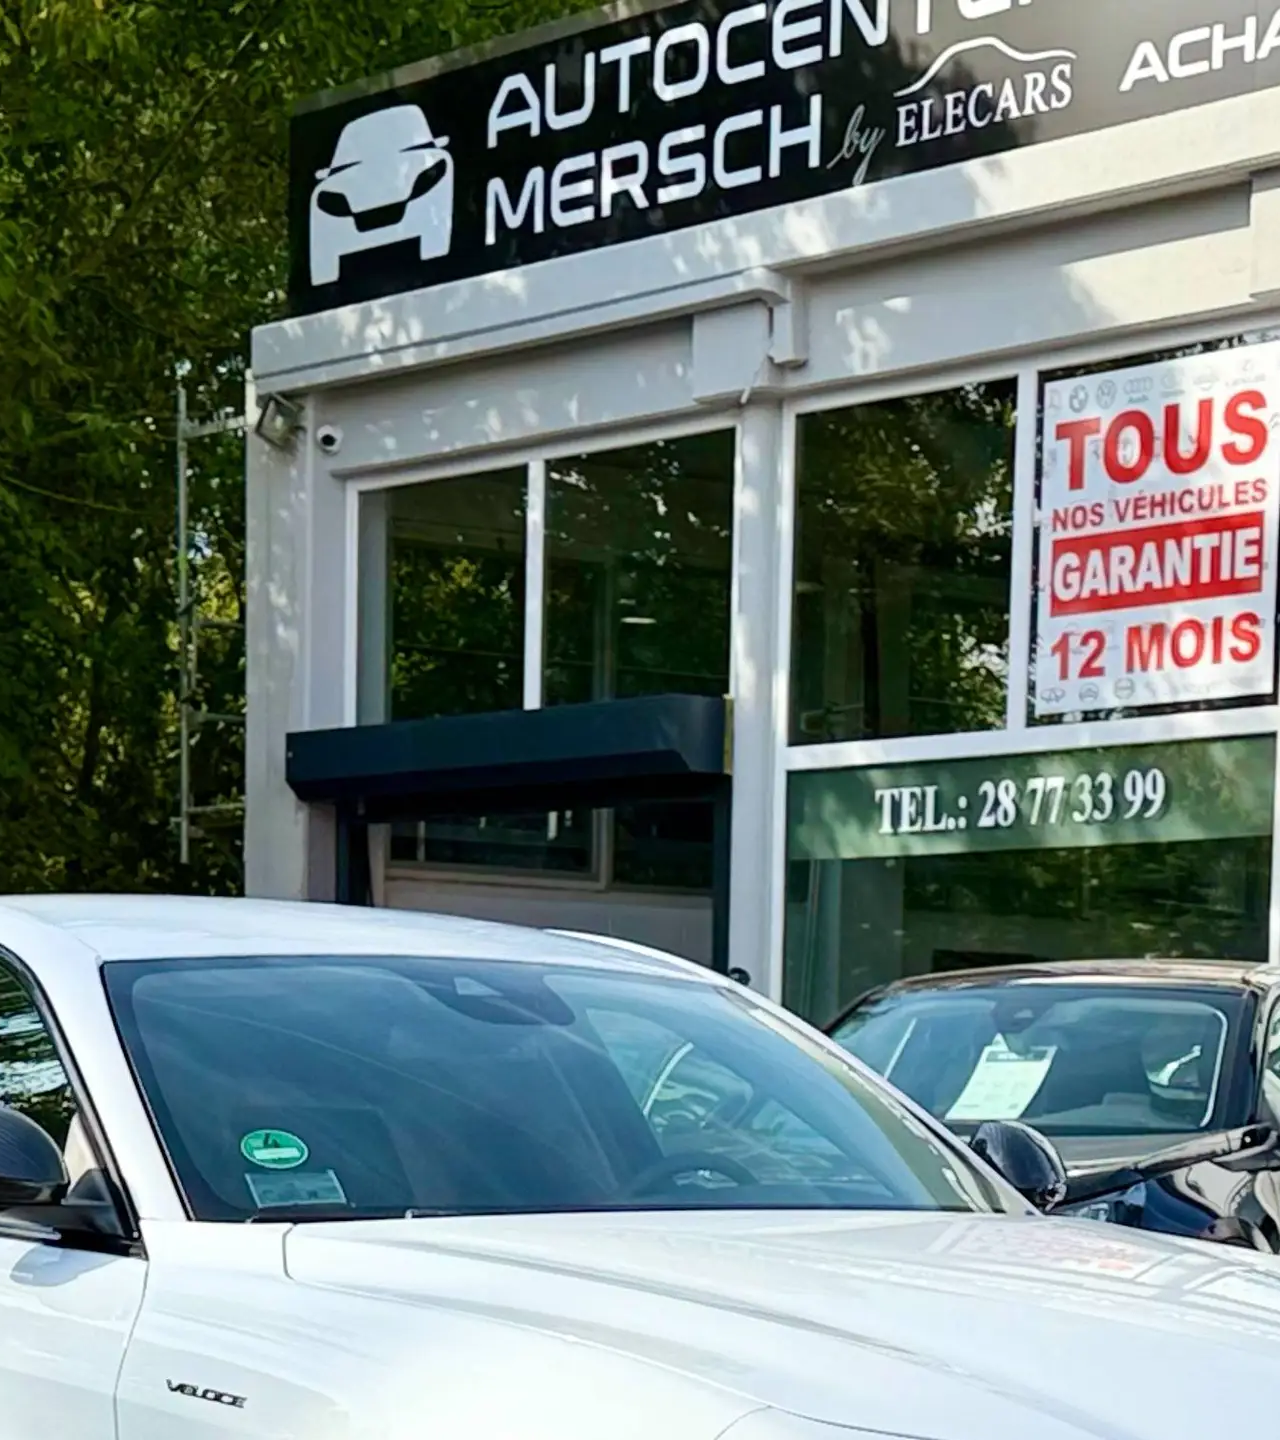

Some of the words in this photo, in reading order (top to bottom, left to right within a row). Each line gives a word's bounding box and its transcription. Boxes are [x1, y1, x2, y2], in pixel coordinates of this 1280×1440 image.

[486, 0, 1031, 149] AUTOCEN
[484, 94, 822, 246] MERSCH
[826, 104, 885, 186] by
[895, 63, 1073, 148] ELECARS
[1055, 389, 1269, 491] TOUS
[1052, 502, 1105, 533] NOS
[1113, 478, 1268, 524] VÉHICULES
[1053, 526, 1261, 602] GARANTIE
[1051, 629, 1107, 681] 12
[1125, 611, 1262, 674] MOIS
[977, 778, 1018, 829] 28
[1027, 776, 1066, 826] 77
[1072, 772, 1114, 824] 33
[1123, 768, 1167, 821] 99
[166, 1378, 248, 1409] VELOCE
